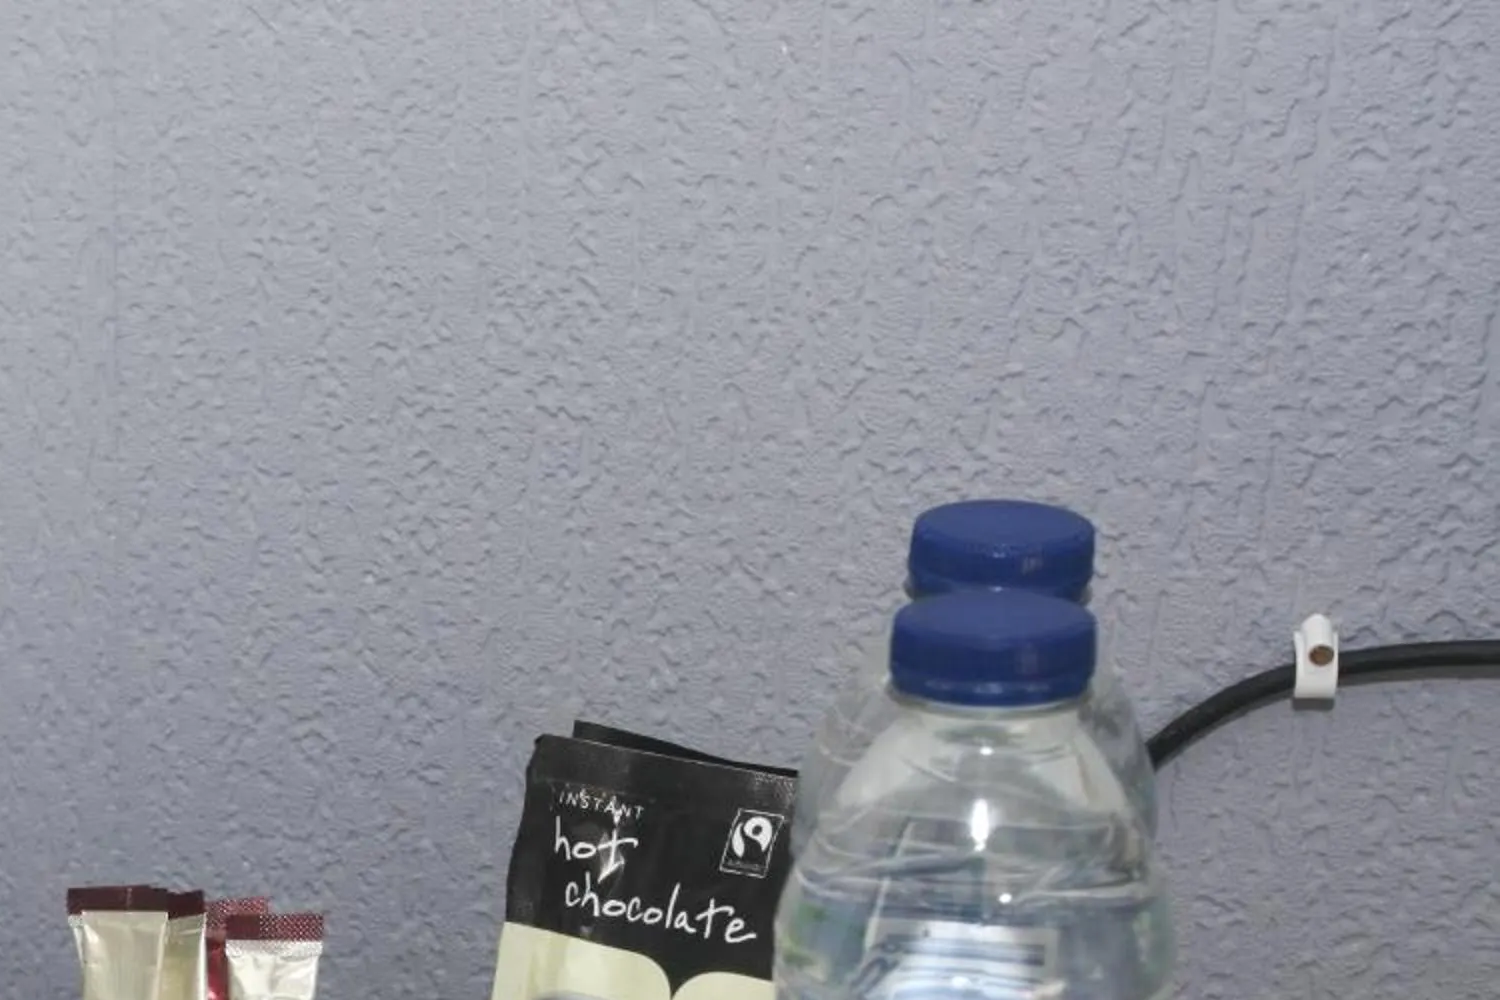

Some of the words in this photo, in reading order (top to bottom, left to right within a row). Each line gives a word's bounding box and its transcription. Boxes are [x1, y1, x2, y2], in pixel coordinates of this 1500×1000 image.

[559, 790, 645, 819] INSTANT
[553, 815, 639, 868] hot
[564, 871, 757, 943] chocolate
